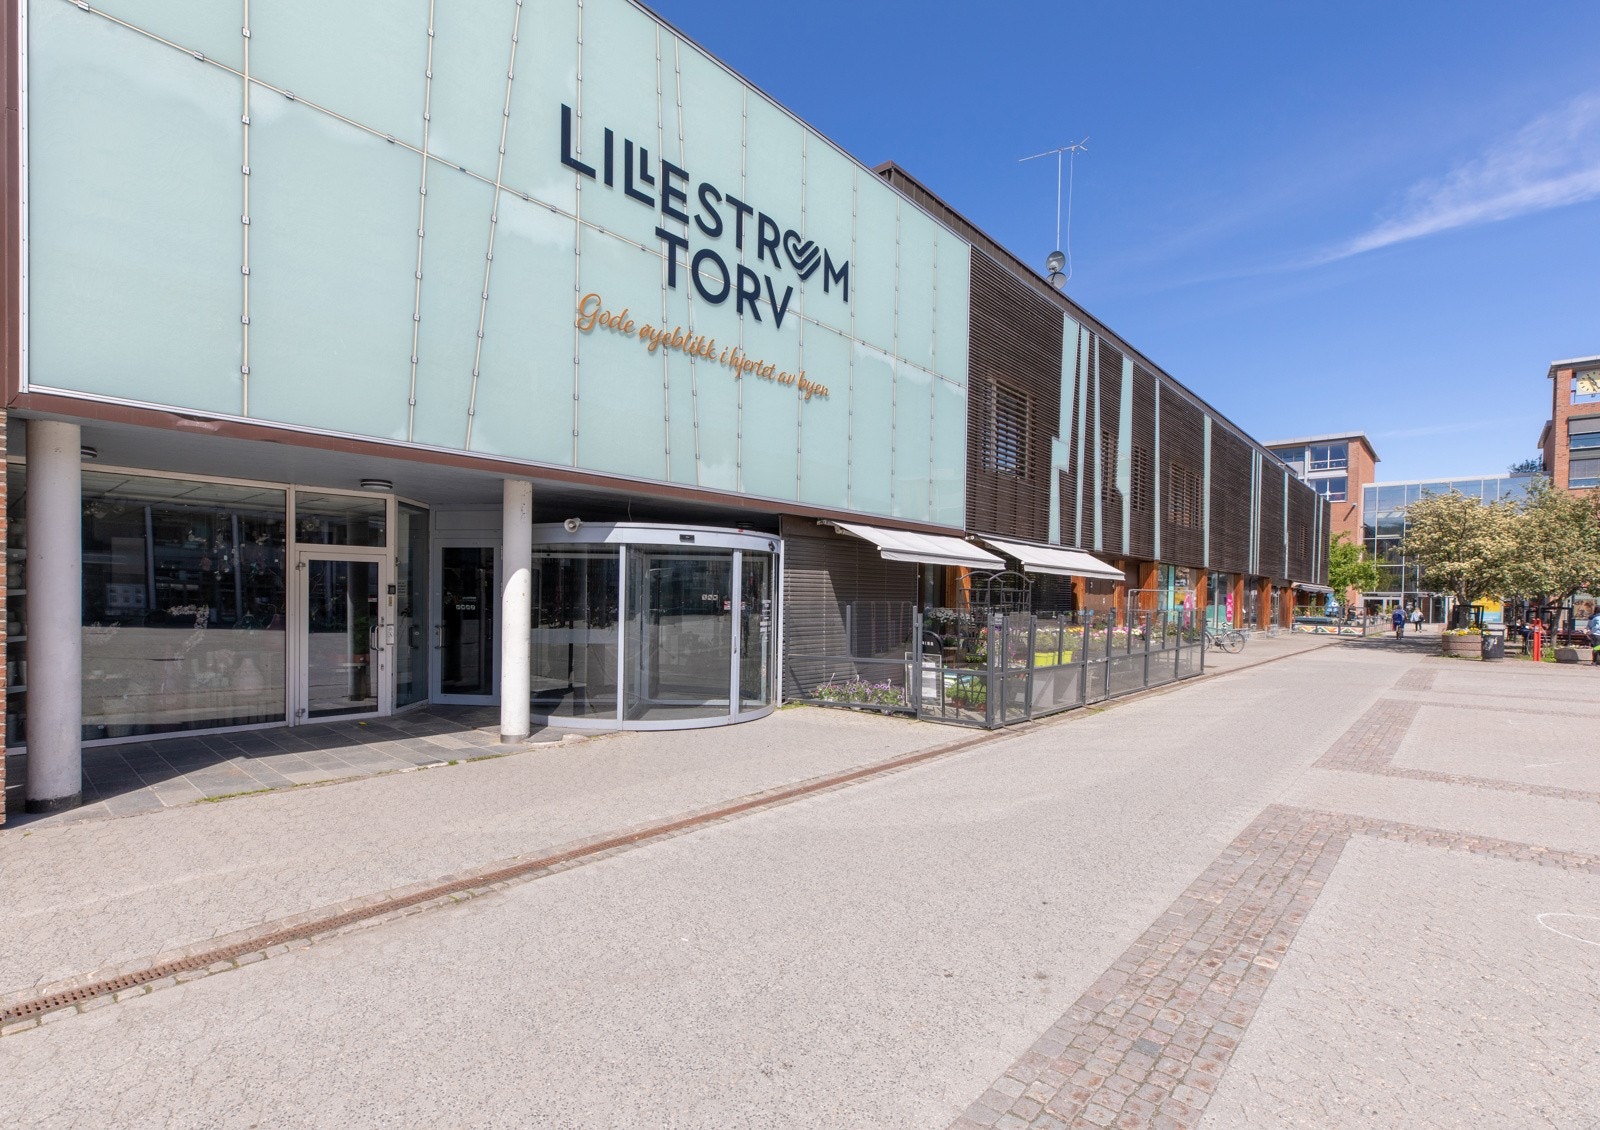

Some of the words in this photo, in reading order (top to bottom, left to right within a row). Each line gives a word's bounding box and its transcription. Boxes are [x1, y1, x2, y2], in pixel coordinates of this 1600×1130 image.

[655, 226, 794, 329] TORV
[577, 293, 636, 332] Gode
[639, 323, 717, 359] øyeblikk
[719, 346, 728, 363] i
[728, 346, 775, 379] hjertet
[778, 371, 796, 385] av
[798, 370, 829, 400] byen
